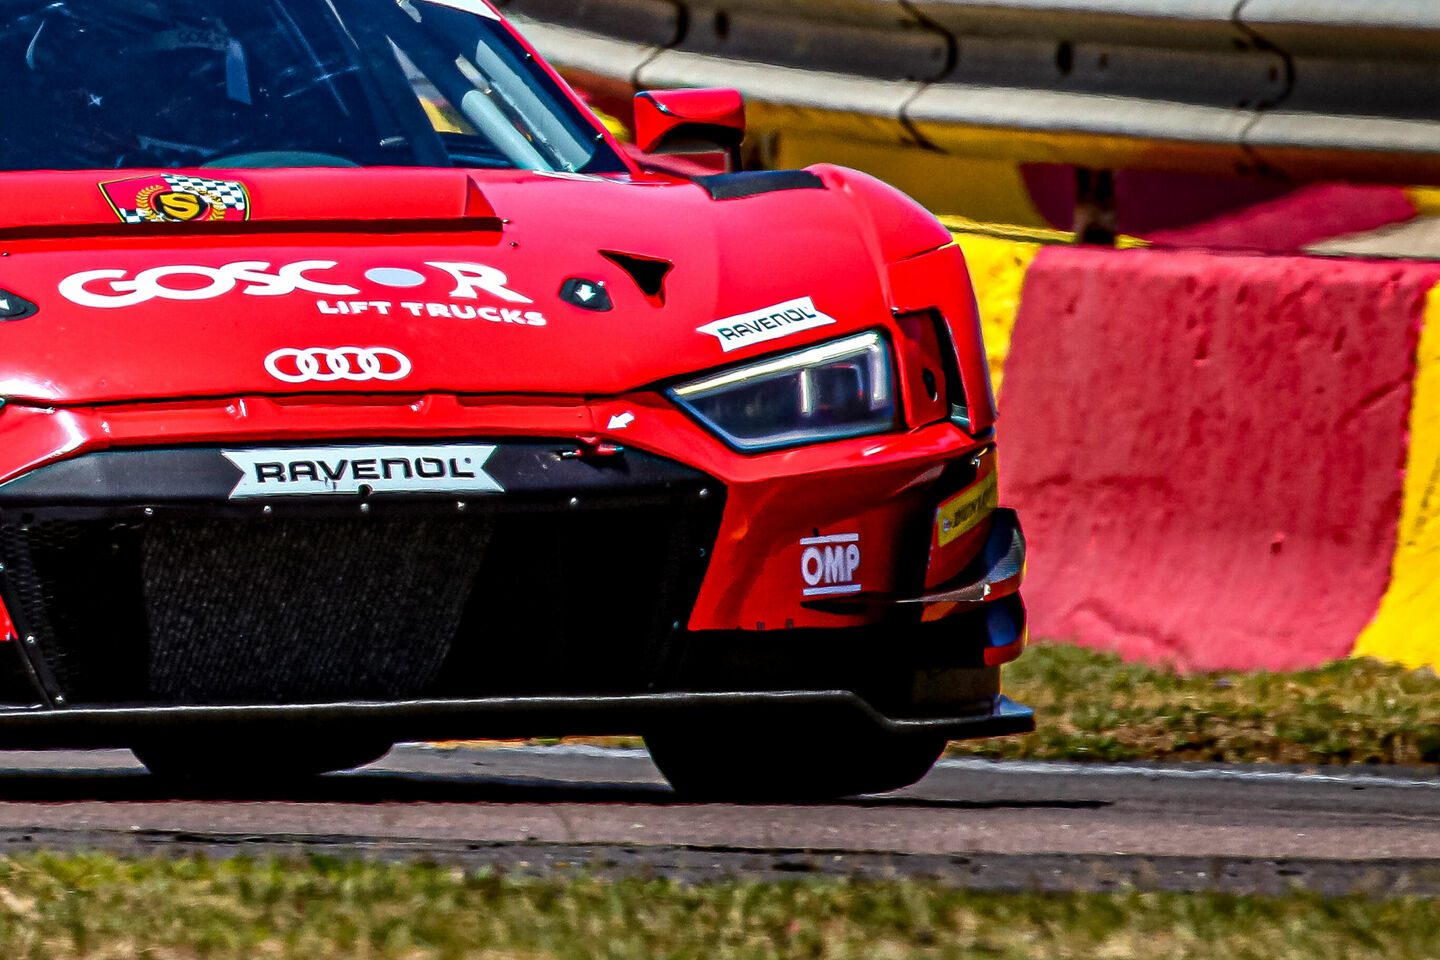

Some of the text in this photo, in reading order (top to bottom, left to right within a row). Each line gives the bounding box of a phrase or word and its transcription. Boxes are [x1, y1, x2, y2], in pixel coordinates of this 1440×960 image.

[316, 300, 547, 326] LIFT TRUCKS
[717, 306, 817, 341] RAVENOL
[255, 457, 476, 483] RAVENOL
[801, 544, 861, 586] OMP
